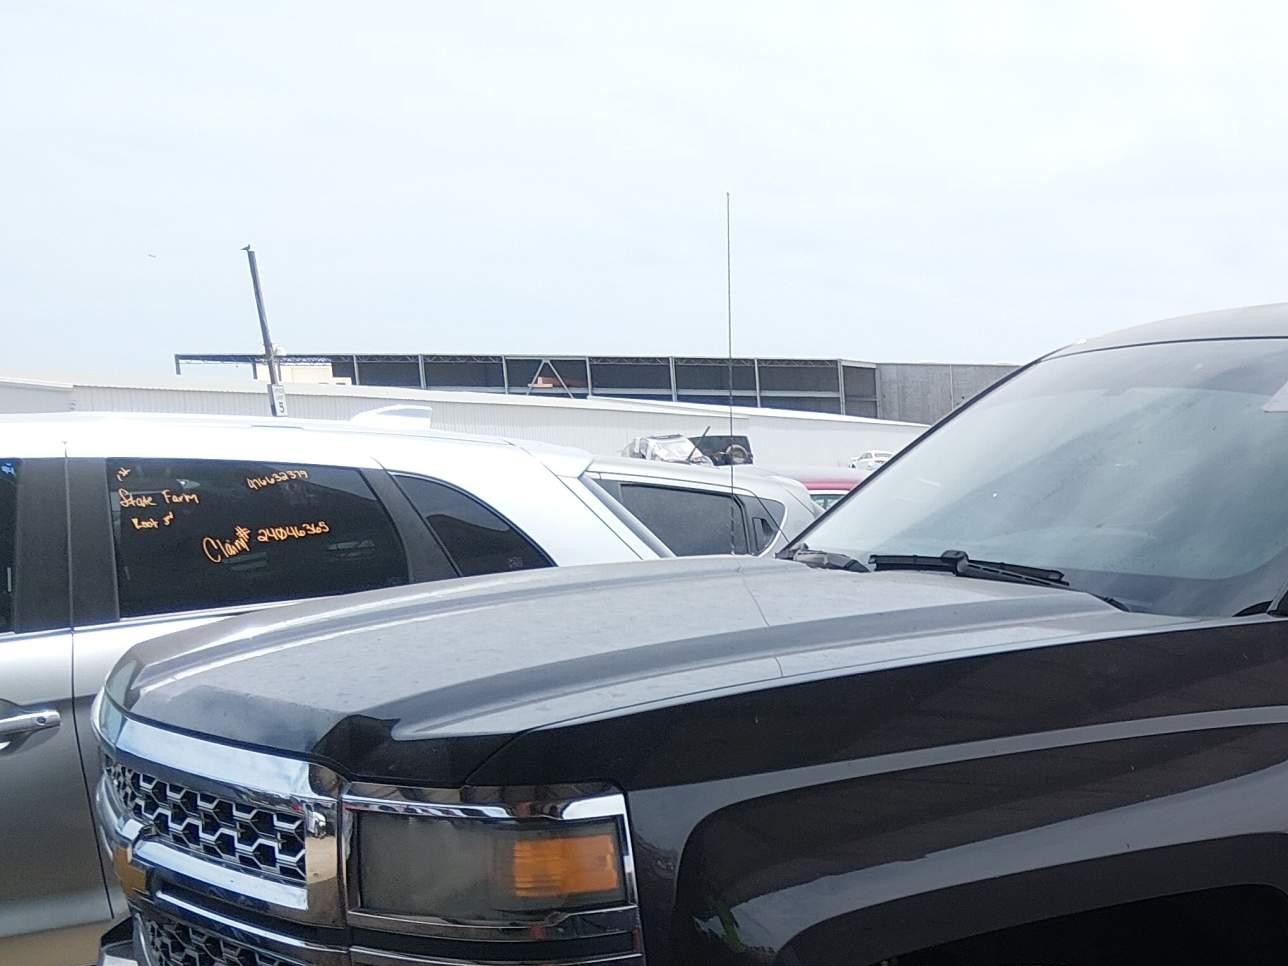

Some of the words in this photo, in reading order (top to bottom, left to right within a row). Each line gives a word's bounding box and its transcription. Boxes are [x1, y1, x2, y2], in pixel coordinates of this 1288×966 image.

[278, 401, 285, 413] 5
[118, 487, 158, 507] State
[160, 488, 200, 504] Farm
